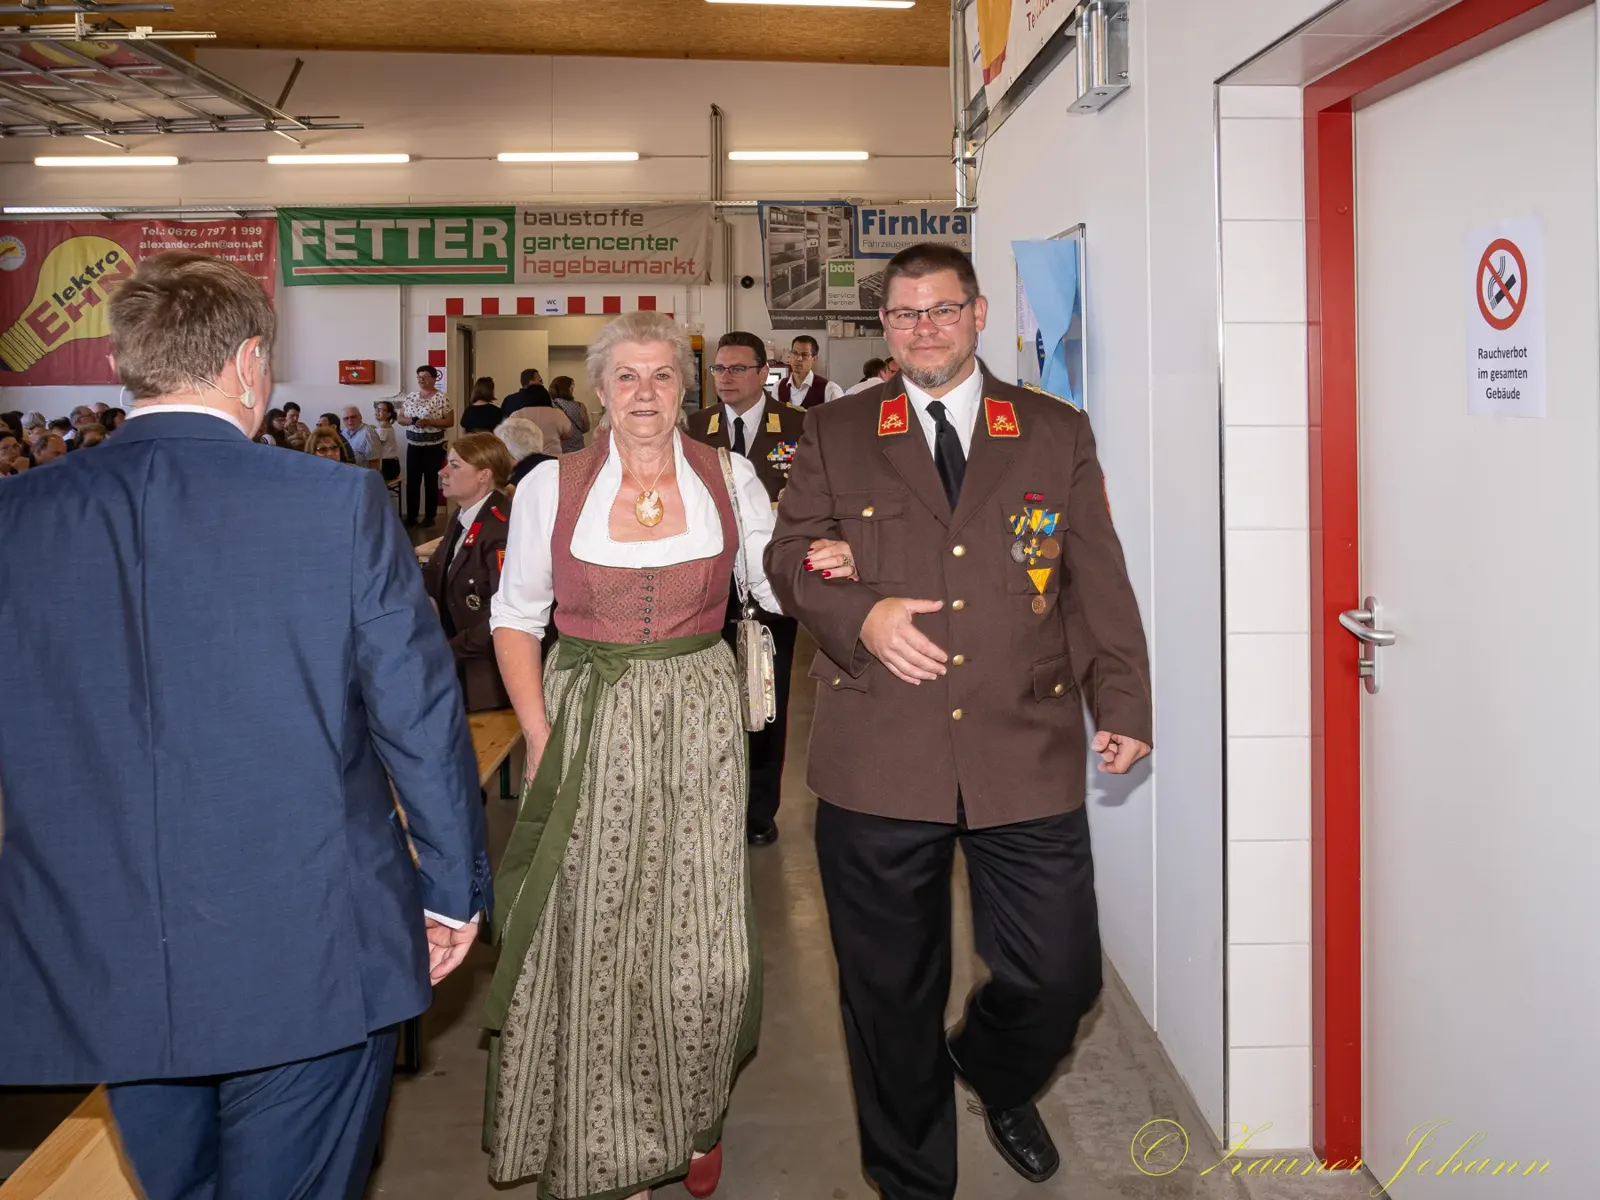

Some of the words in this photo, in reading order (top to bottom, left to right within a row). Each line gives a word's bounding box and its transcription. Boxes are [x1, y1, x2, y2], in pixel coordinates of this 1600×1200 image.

[523, 209, 644, 227] baustoffe
[861, 208, 972, 236] Firnkra
[141, 226, 165, 236] Tel.:
[167, 227, 197, 237] 0676
[207, 226, 226, 236] 797
[231, 227, 237, 236] 1
[241, 226, 262, 236] 999
[140, 240, 263, 249] alexander.ehn@aon.at
[291, 218, 508, 260] FETTER
[523, 233, 679, 255] gartencenter
[523, 256, 696, 278] hagebaumarkt
[829, 263, 856, 273] bott
[1478, 346, 1528, 360] Rauchverbot
[1478, 367, 1488, 379] im
[1491, 368, 1528, 381] gesamten
[1486, 387, 1521, 400] Gebäude
